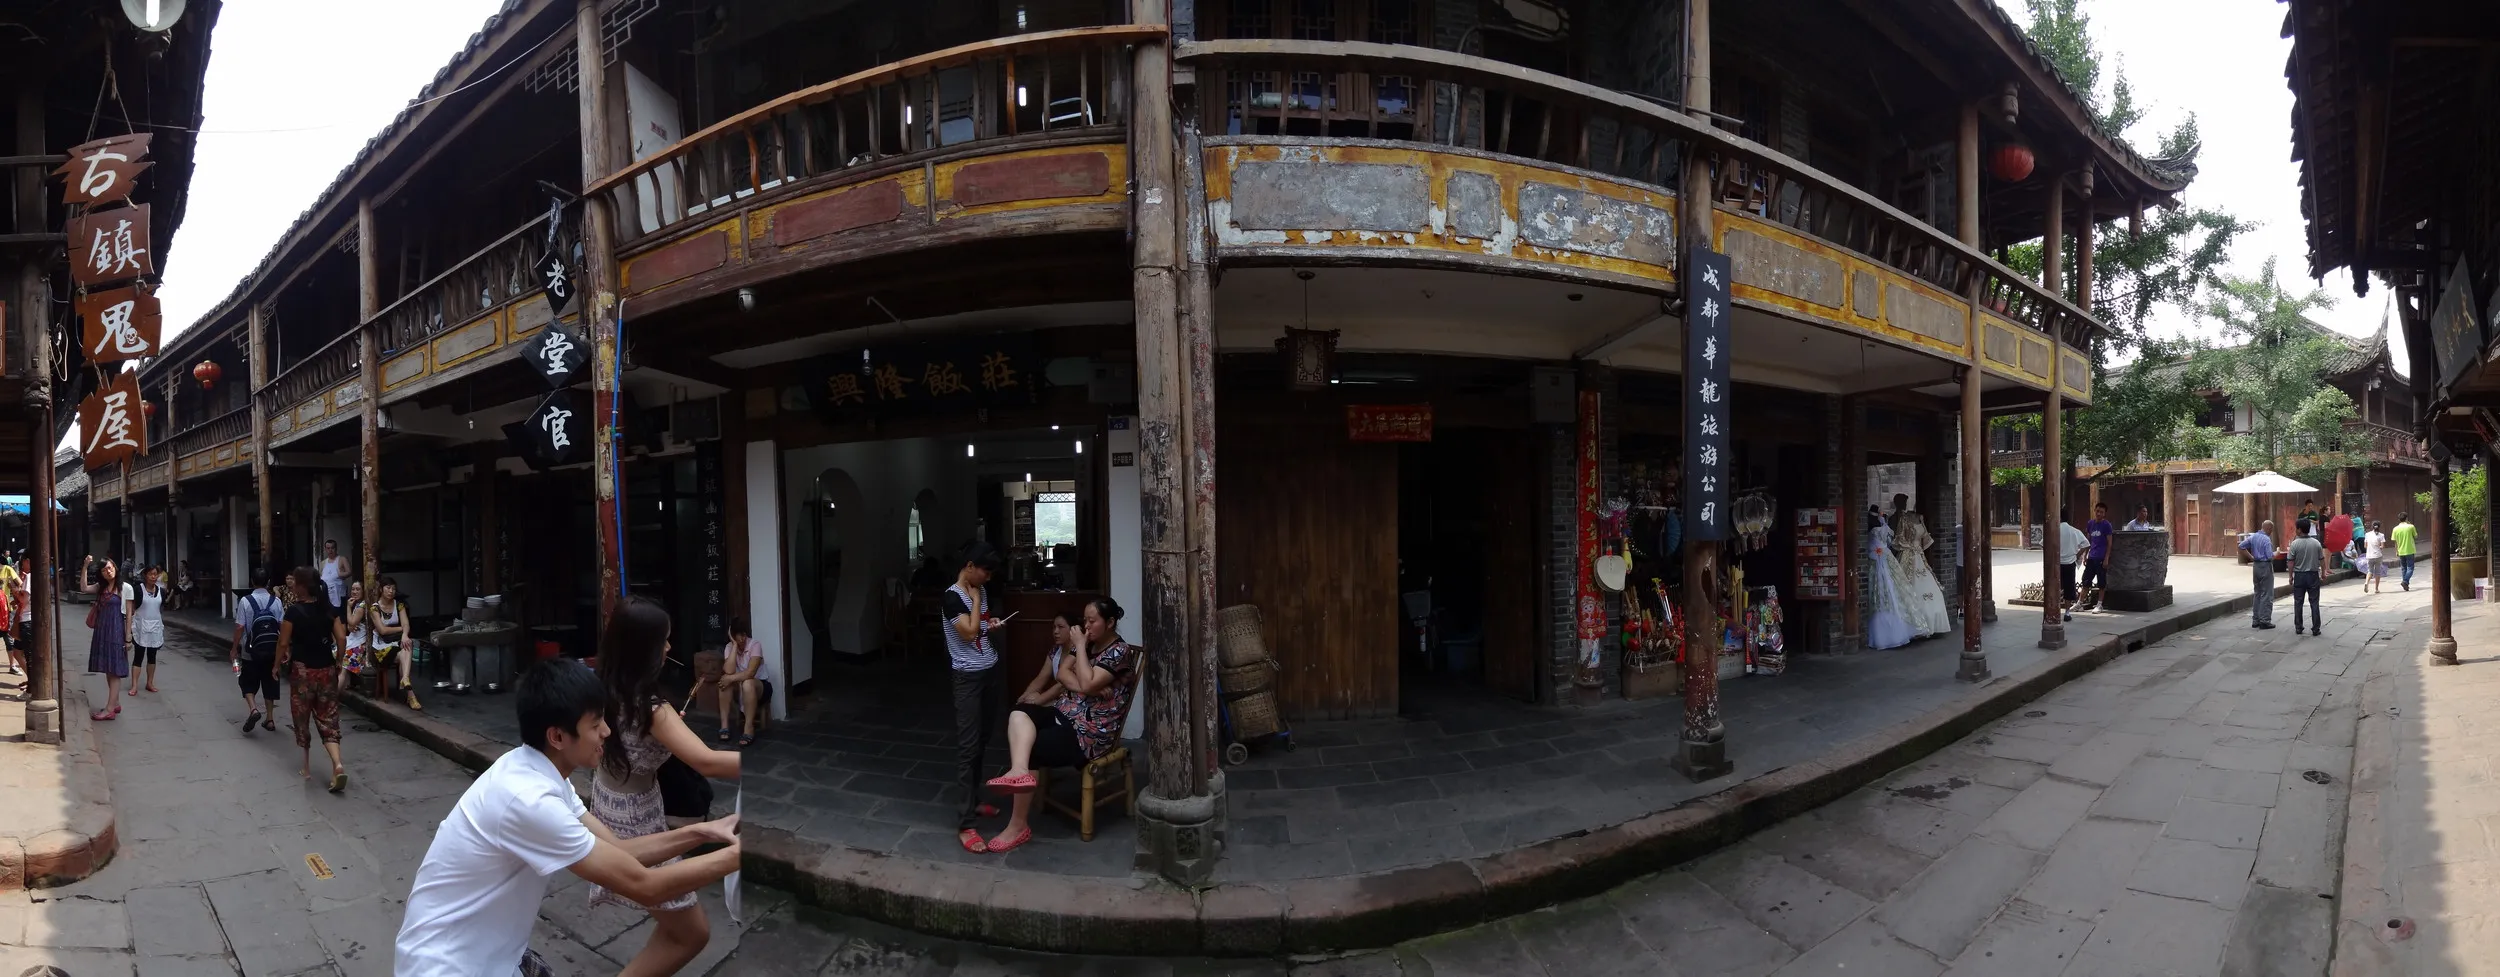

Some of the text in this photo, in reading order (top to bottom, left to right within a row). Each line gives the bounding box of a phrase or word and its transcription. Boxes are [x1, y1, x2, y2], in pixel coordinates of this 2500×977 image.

[80, 140, 149, 455] 古鎮鬼屋
[826, 351, 1019, 407] 興隆飯莊
[1699, 264, 1721, 526] 成都華龍旅游公司
